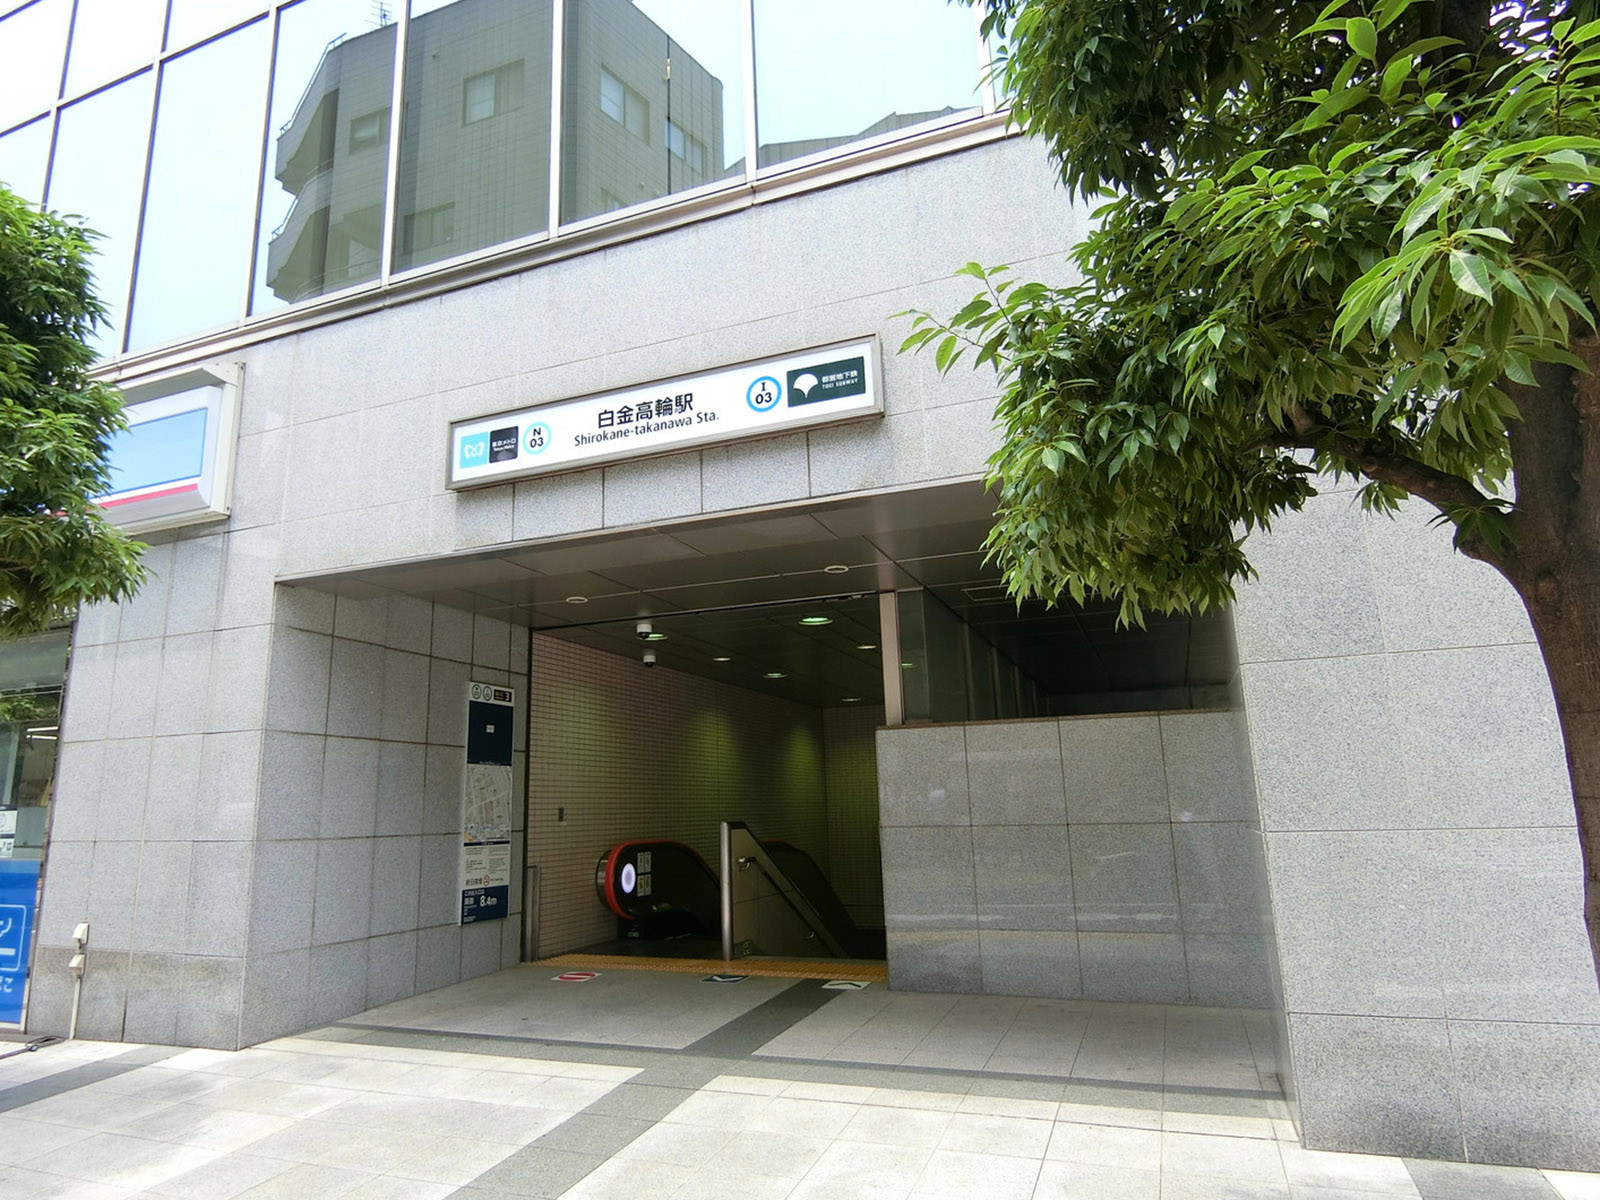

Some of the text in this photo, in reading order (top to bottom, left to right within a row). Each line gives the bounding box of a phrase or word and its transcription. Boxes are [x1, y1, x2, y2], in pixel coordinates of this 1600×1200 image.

[835, 378, 858, 387] SUBWAY
[755, 392, 772, 405] 03
[598, 393, 693, 429] 白金高輪駅
[533, 427, 541, 437] N
[574, 411, 720, 447] Shirokane-takanawa Sta.
[530, 437, 544, 448] 03
[505, 692, 510, 702] 3
[480, 895, 498, 907] 8.4m
